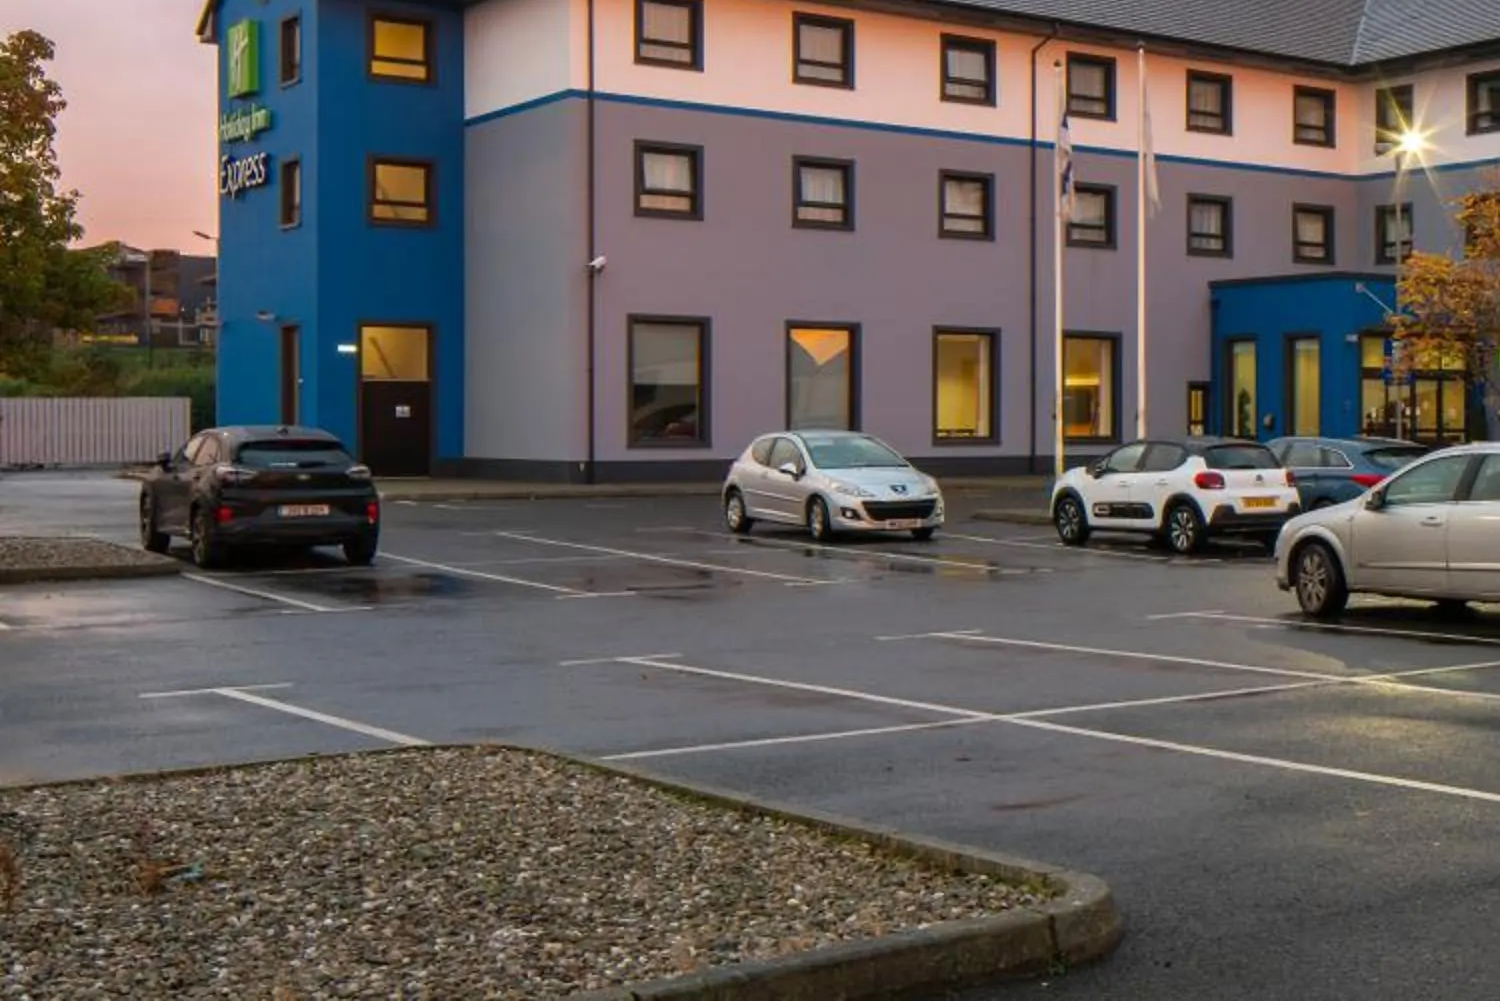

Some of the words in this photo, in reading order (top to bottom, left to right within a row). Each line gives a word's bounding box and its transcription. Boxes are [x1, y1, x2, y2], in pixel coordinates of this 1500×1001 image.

[220, 110, 251, 141] Holiday
[251, 103, 268, 130] Inn
[220, 152, 267, 199] Express
